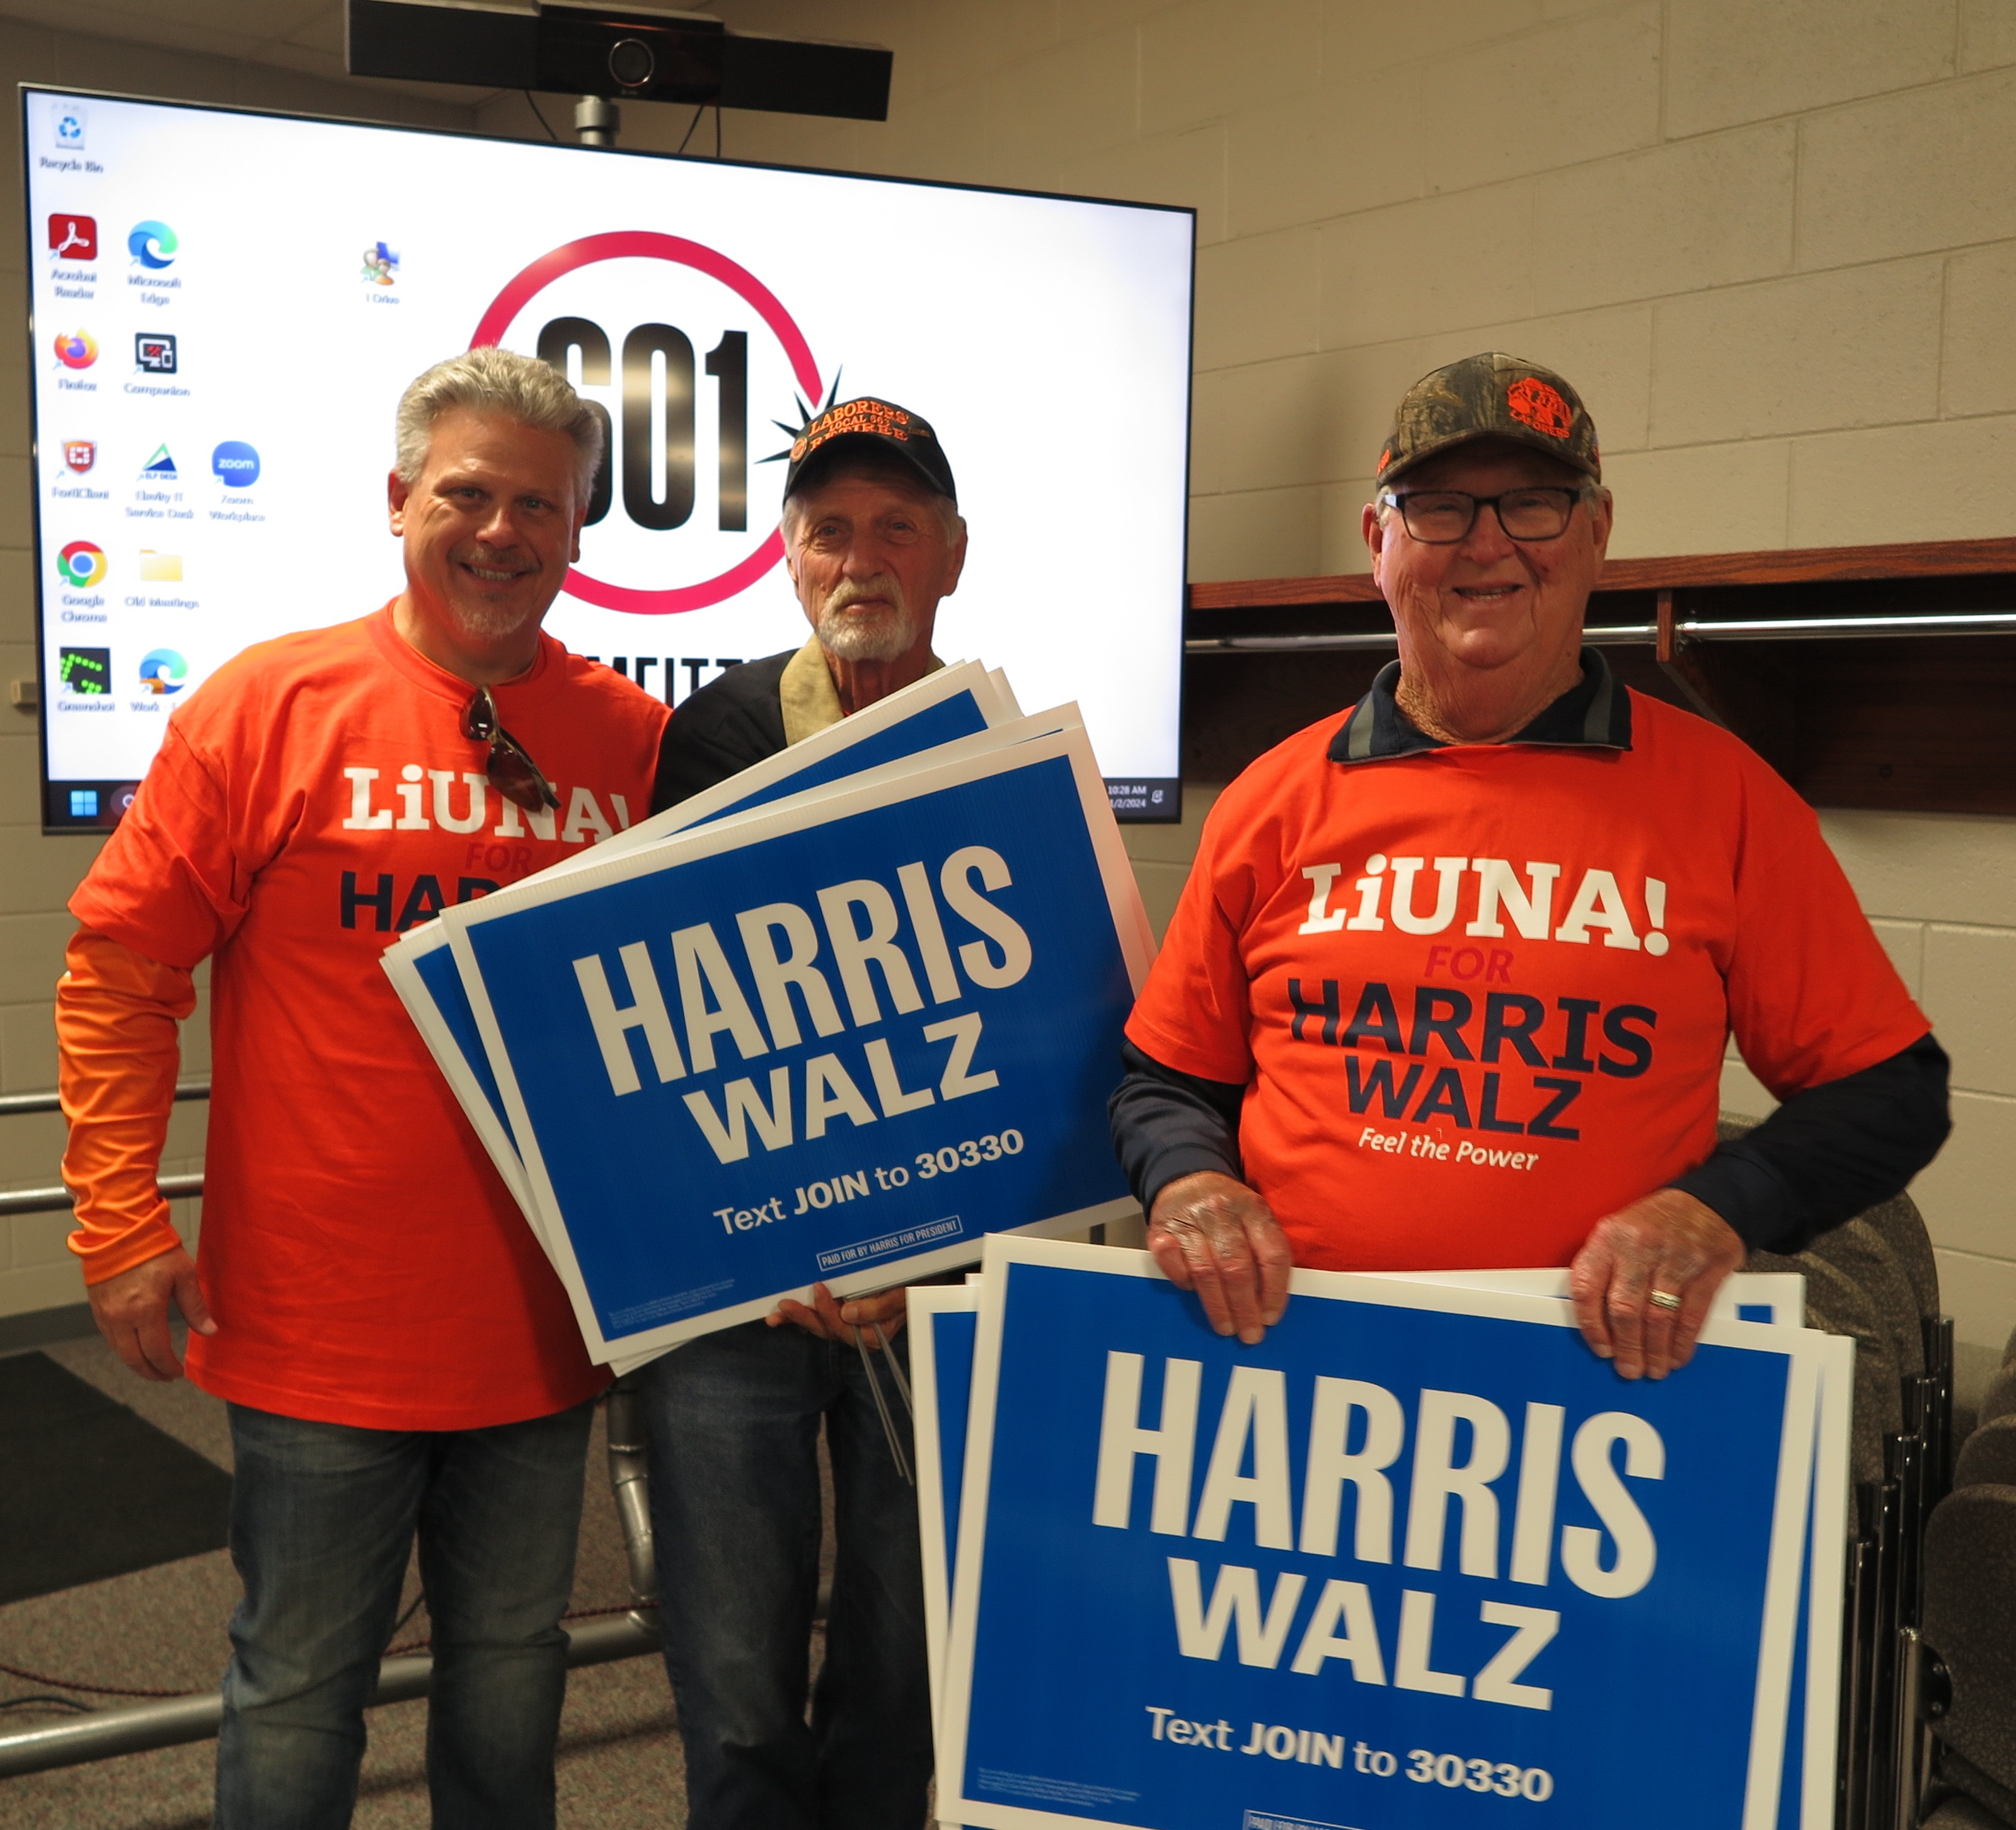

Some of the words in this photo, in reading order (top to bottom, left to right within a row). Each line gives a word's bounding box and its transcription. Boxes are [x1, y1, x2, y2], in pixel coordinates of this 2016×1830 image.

[39, 157, 82, 172] Recycle
[85, 161, 104, 173] Bin
[51, 268, 97, 282] Acrobat
[127, 275, 181, 289] Microsoft
[55, 286, 94, 299] Reader
[141, 292, 170, 306] Edge
[58, 379, 97, 391] Firefox
[124, 383, 191, 398] Companion
[809, 400, 909, 437] LABORERS
[829, 415, 867, 432] LOCAL
[218, 458, 255, 470] zoom
[221, 495, 253, 505] Zoom
[125, 506, 164, 518] Service
[167, 507, 194, 519] Desk
[209, 510, 266, 523] Workplace
[62, 594, 105, 608] Google
[124, 596, 145, 607] Old
[149, 598, 199, 610] Meetings
[60, 611, 107, 623] Chrome
[129, 701, 160, 712] Work
[1131, 785, 1146, 795] AM
[465, 841, 533, 875] FOR
[1298, 853, 1669, 957] LiUNA!
[572, 845, 1032, 1096] HARRIS
[1424, 944, 1514, 984] FOR
[1287, 979, 1657, 1079] HARRIS
[682, 1011, 999, 1164] WALZ
[1345, 1056, 1582, 1141] WALZ
[1358, 1127, 1407, 1155] Feel
[1412, 1132, 1451, 1161] the
[1455, 1141, 1539, 1171] Power
[712, 1196, 787, 1234] Text
[793, 1170, 870, 1216] JOIN
[875, 1166, 910, 1191] to
[914, 1128, 1024, 1180] 30330
[821, 1253, 840, 1267] PAID
[841, 1250, 857, 1262] FOR
[858, 1246, 868, 1257] BY
[869, 1237, 899, 1254] HARRIS
[899, 1233, 916, 1245] FOR
[915, 1220, 958, 1241] PRESIDENT
[1092, 1350, 1666, 1599] HARRIS
[1166, 1556, 1562, 1711] WALZ
[1144, 1705, 1234, 1752] Text
[1240, 1722, 1344, 1770] JOIN
[1353, 1742, 1397, 1778] to
[1406, 1749, 1554, 1803] 30330
